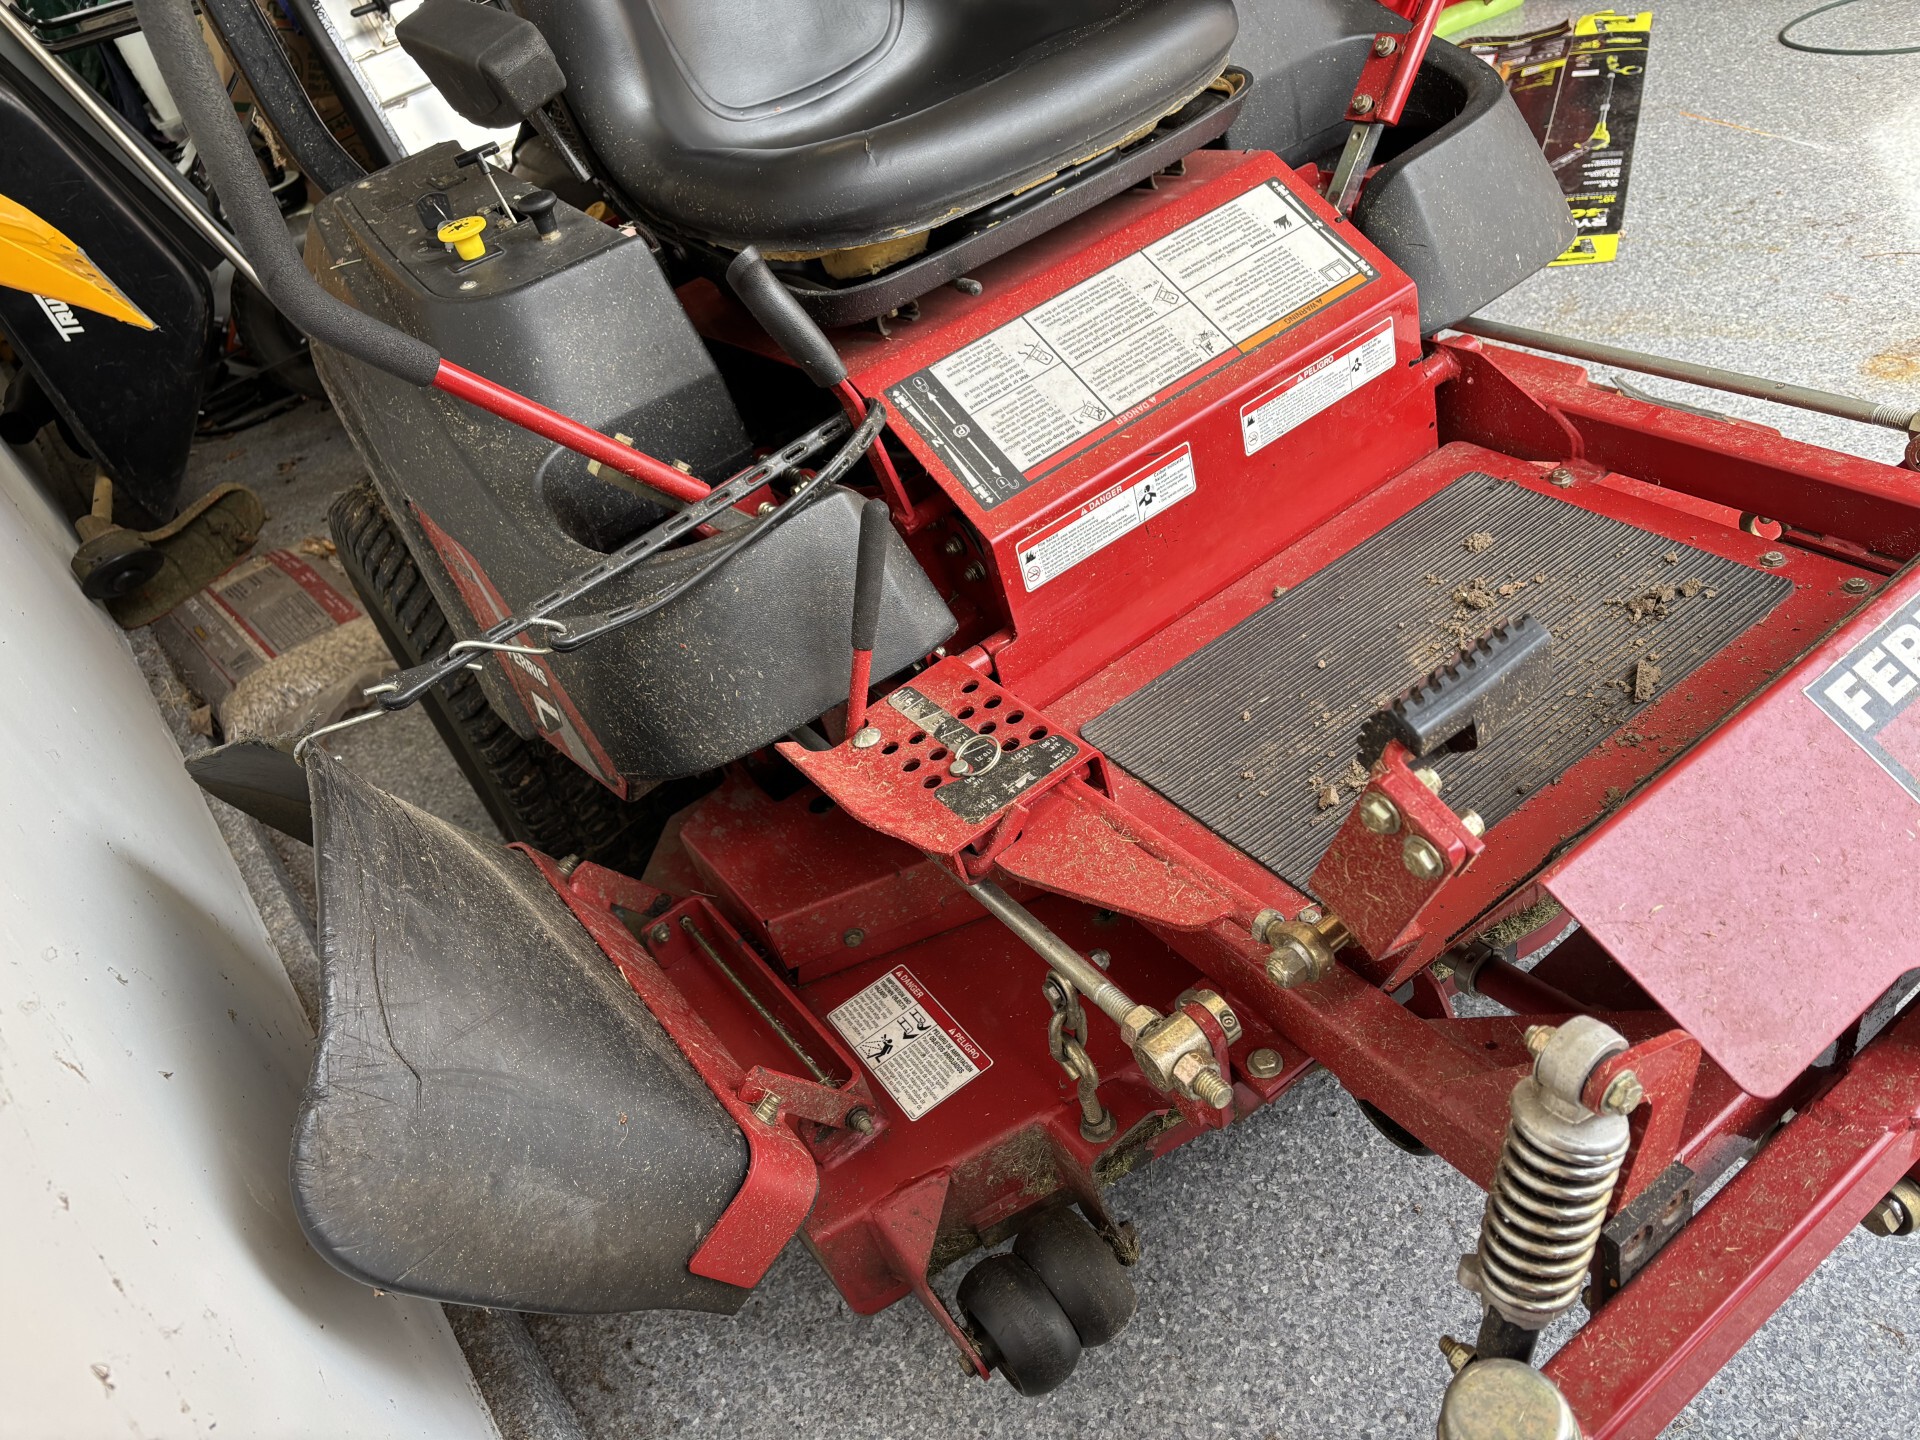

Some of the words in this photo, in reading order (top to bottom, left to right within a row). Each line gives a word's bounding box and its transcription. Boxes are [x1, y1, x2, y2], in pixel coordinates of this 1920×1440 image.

[1310, 219, 1323, 229] N
[1249, 237, 1266, 248] Hazard
[1314, 282, 1329, 292] Avoid
[1297, 290, 1316, 302] serious
[1124, 306, 1138, 315] cause
[1284, 299, 1299, 310] injury
[33, 294, 85, 342] TRU
[1129, 305, 1152, 320] Operating
[1143, 311, 1157, 320] Loss
[1265, 311, 1280, 321] death
[1282, 301, 1318, 324] WARNING
[1092, 322, 1110, 333] control
[1107, 321, 1124, 332] slopes
[1120, 321, 1139, 333] control
[1083, 331, 1093, 339] and
[1111, 330, 1122, 338] and
[1061, 337, 1084, 351] roll-overs.
[1067, 339, 1093, 355] hazardous
[1090, 336, 1112, 350] roll-over
[1073, 347, 1091, 359] hazard
[1177, 351, 1198, 365] Rotating
[1004, 363, 1020, 372] cause
[1013, 368, 1024, 376] Wet
[1162, 363, 1179, 374] blades
[1173, 357, 1203, 375] Amputation
[1303, 354, 1333, 379] PELIGRO
[988, 370, 1005, 382] sliding
[998, 376, 1009, 384] soft
[1018, 373, 1029, 381] Wet
[1157, 373, 1175, 385] hazard
[968, 385, 979, 393] loss
[978, 380, 989, 388] and
[981, 381, 999, 393] slopes
[1001, 382, 1012, 390] soft
[1135, 380, 1149, 389] arms
[986, 388, 1002, 399] slope
[1115, 392, 1127, 401] legs.
[1126, 387, 1136, 395] and
[968, 397, 987, 409] hazard
[1049, 413, 1066, 424] edges
[1114, 401, 1150, 424] DANGER
[1039, 422, 1050, 430] may
[1052, 419, 1071, 432] Wheels
[1064, 424, 1076, 433] and
[1025, 429, 1040, 439] result
[1030, 428, 1053, 444] dropping
[1043, 429, 1066, 444] drop-off
[1063, 429, 1081, 441] Water,
[931, 436, 944, 447] N
[1002, 440, 1021, 452] serious
[1019, 442, 1031, 450] over
[1040, 438, 1064, 454] retaining
[1023, 442, 1045, 457] hazards
[1026, 452, 1042, 462] walls
[1088, 485, 1122, 510] DANGER
[1824, 609, 1920, 731] FER
[973, 748, 993, 762] (10.2)
[1049, 755, 1067, 768] INCHES
[873, 984, 888, 999] HAZARD
[884, 976, 905, 997] AMPUTATION
[902, 995, 912, 1004] AND
[899, 974, 924, 998] DANGER
[878, 980, 894, 996] THROWN
[891, 994, 907, 1010] OBJECTS
[931, 1028, 948, 1044] PELIGRO
[949, 1047, 974, 1072] AMPUTACIÓN
[952, 1032, 980, 1059] PELIGRO
[928, 1035, 945, 1052] OBJETOS
[942, 1050, 965, 1074] ARROJADOS
